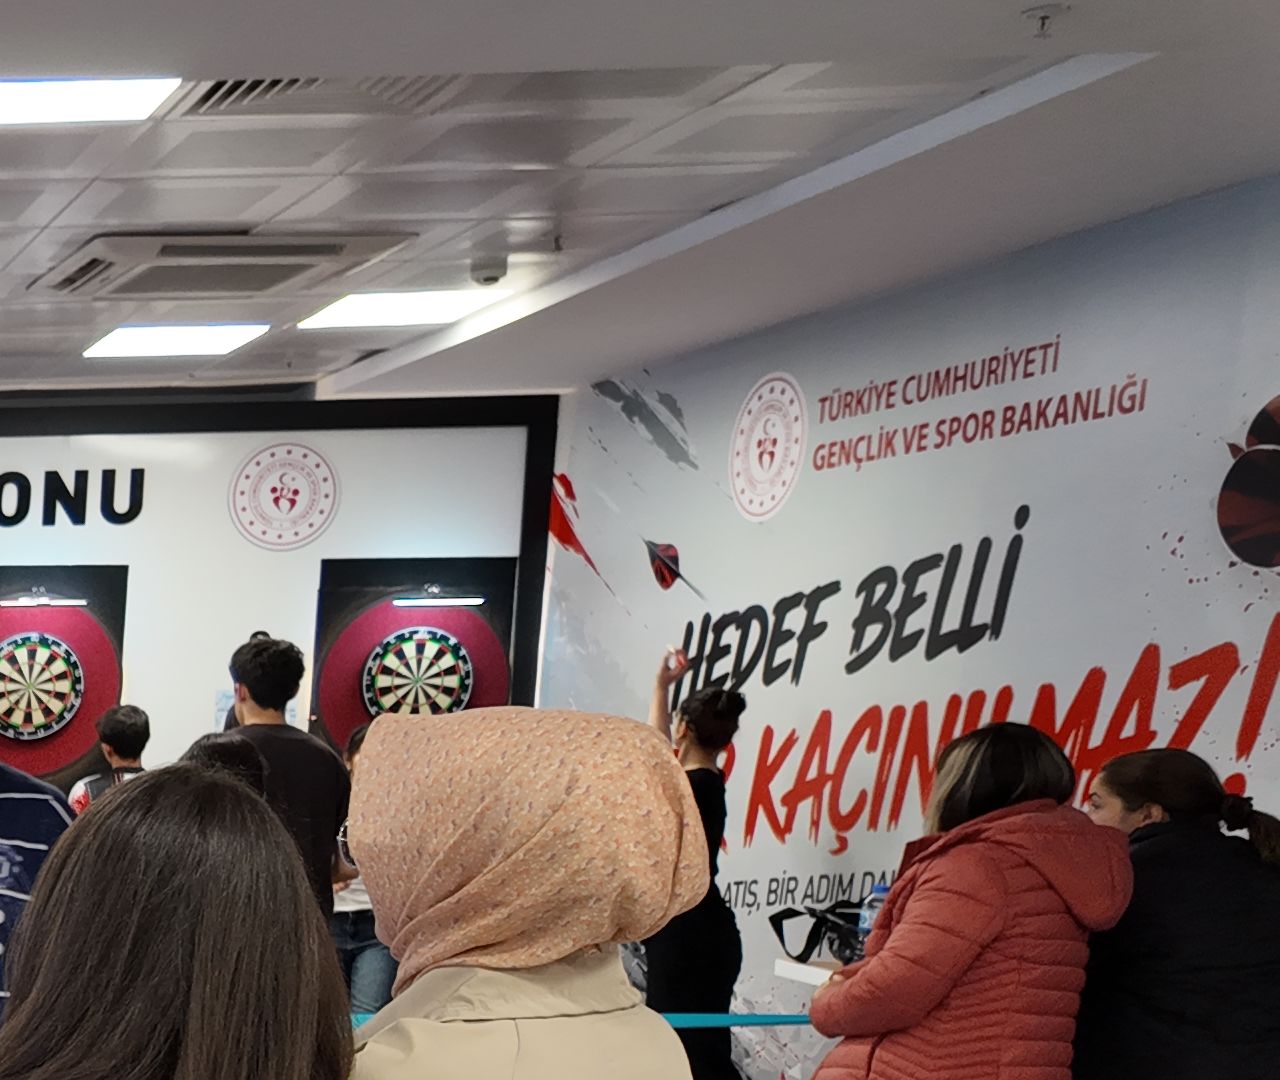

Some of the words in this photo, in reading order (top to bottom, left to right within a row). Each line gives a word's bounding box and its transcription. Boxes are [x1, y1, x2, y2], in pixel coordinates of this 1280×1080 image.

[812, 425, 898, 472] GENÇLİK
[902, 422, 930, 455] VE
[933, 409, 996, 450] SPOR
[1000, 373, 1149, 437] BAKANLIĞI
[818, 380, 898, 424] TÜRKİYE
[902, 334, 1062, 406] CUMHURİYETİ
[670, 580, 841, 712] HEDEF
[844, 503, 1031, 676] BELLİ
[743, 611, 1280, 856] KAÇINMAZ!
[766, 869, 799, 907] BİR
[800, 871, 855, 906] ADIM
